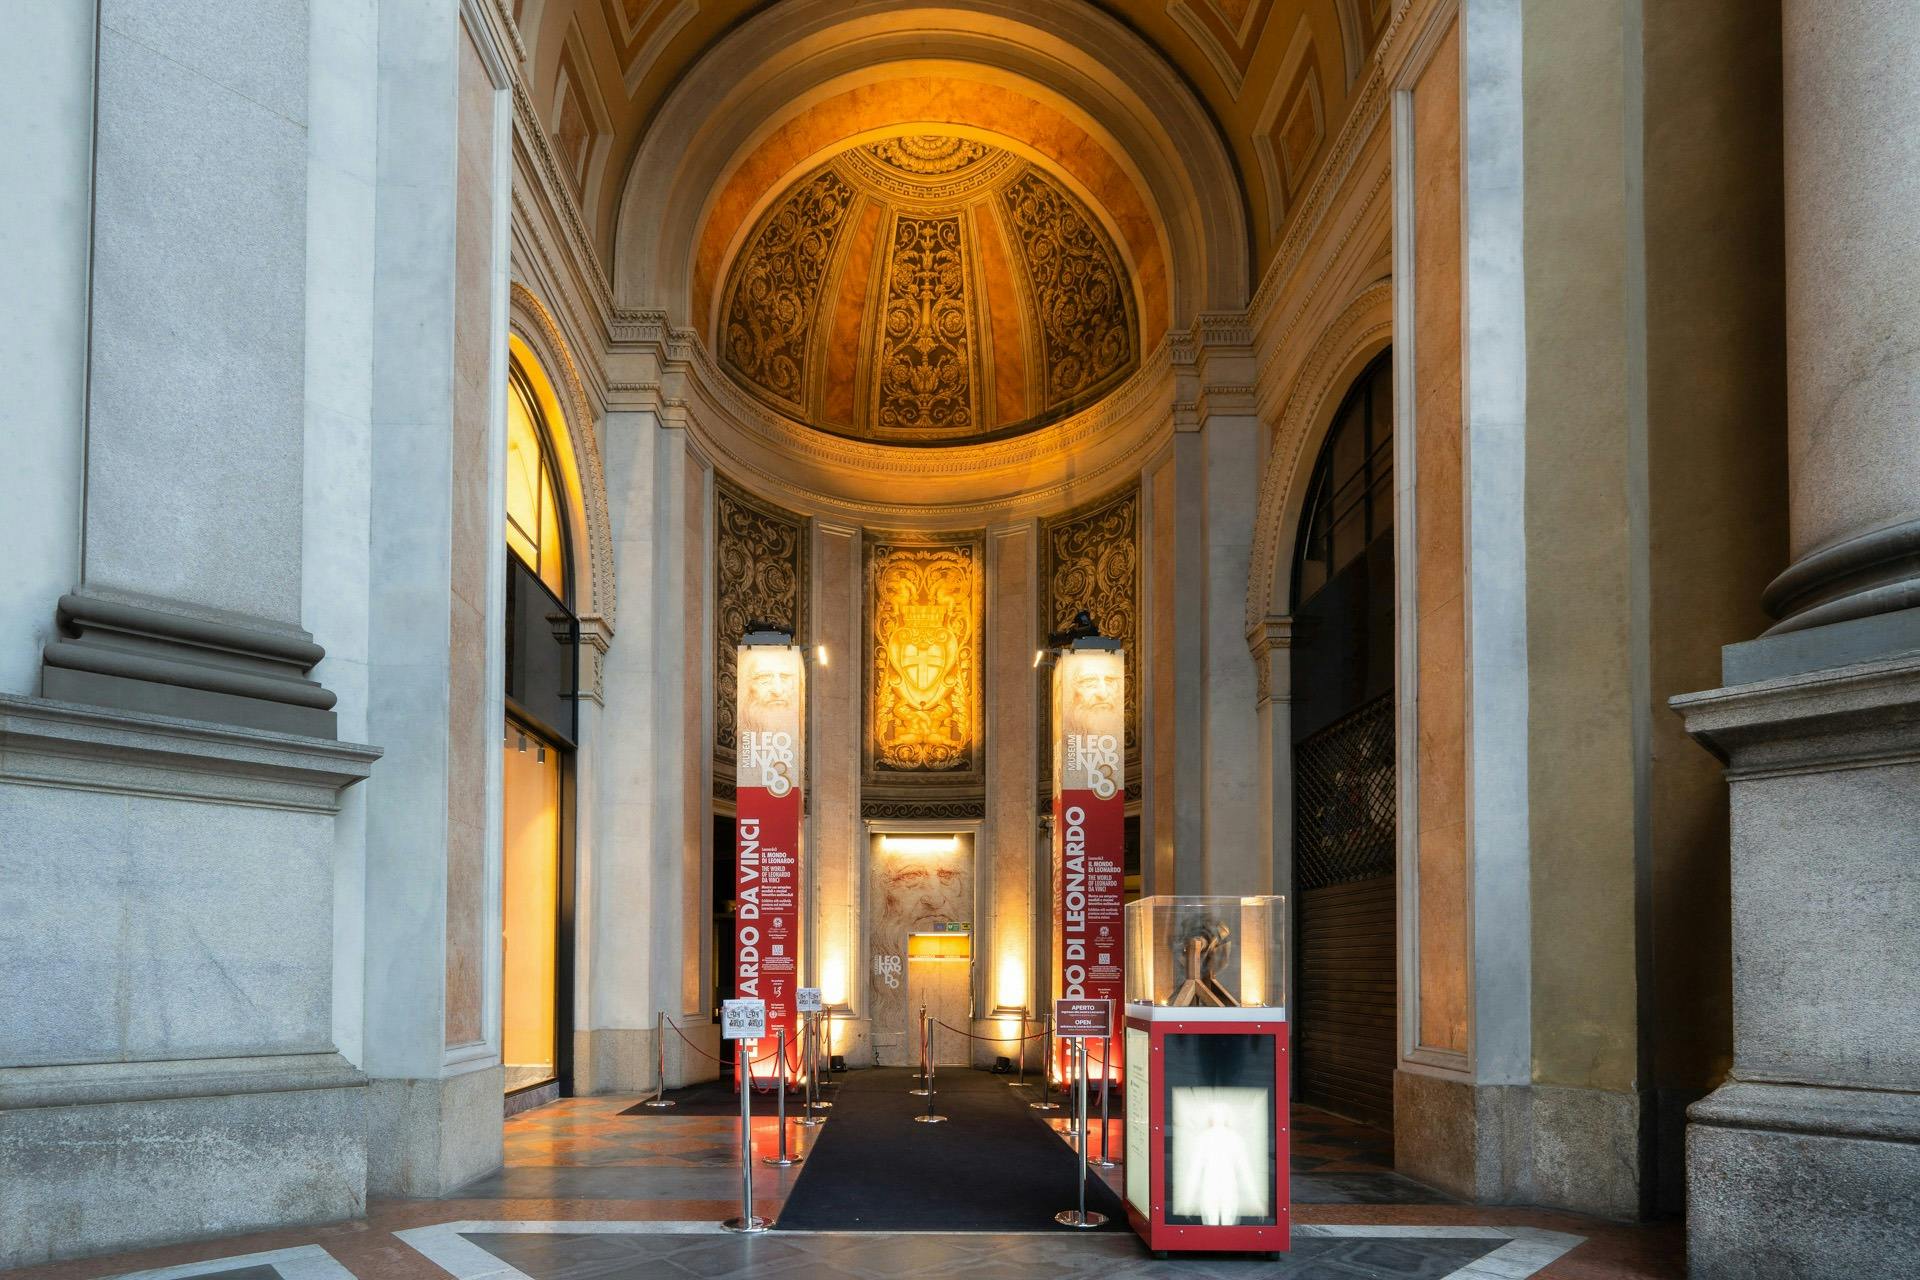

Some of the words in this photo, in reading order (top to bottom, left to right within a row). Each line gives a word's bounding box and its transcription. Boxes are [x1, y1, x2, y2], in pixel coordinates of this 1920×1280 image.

[742, 731, 751, 768] MUSEUM
[1067, 734, 1076, 771] MUSEUM
[740, 818, 760, 884] VINCI
[1066, 806, 1086, 932] LEONARDO
[740, 887, 759, 919] DA
[1066, 939, 1085, 960] DI
